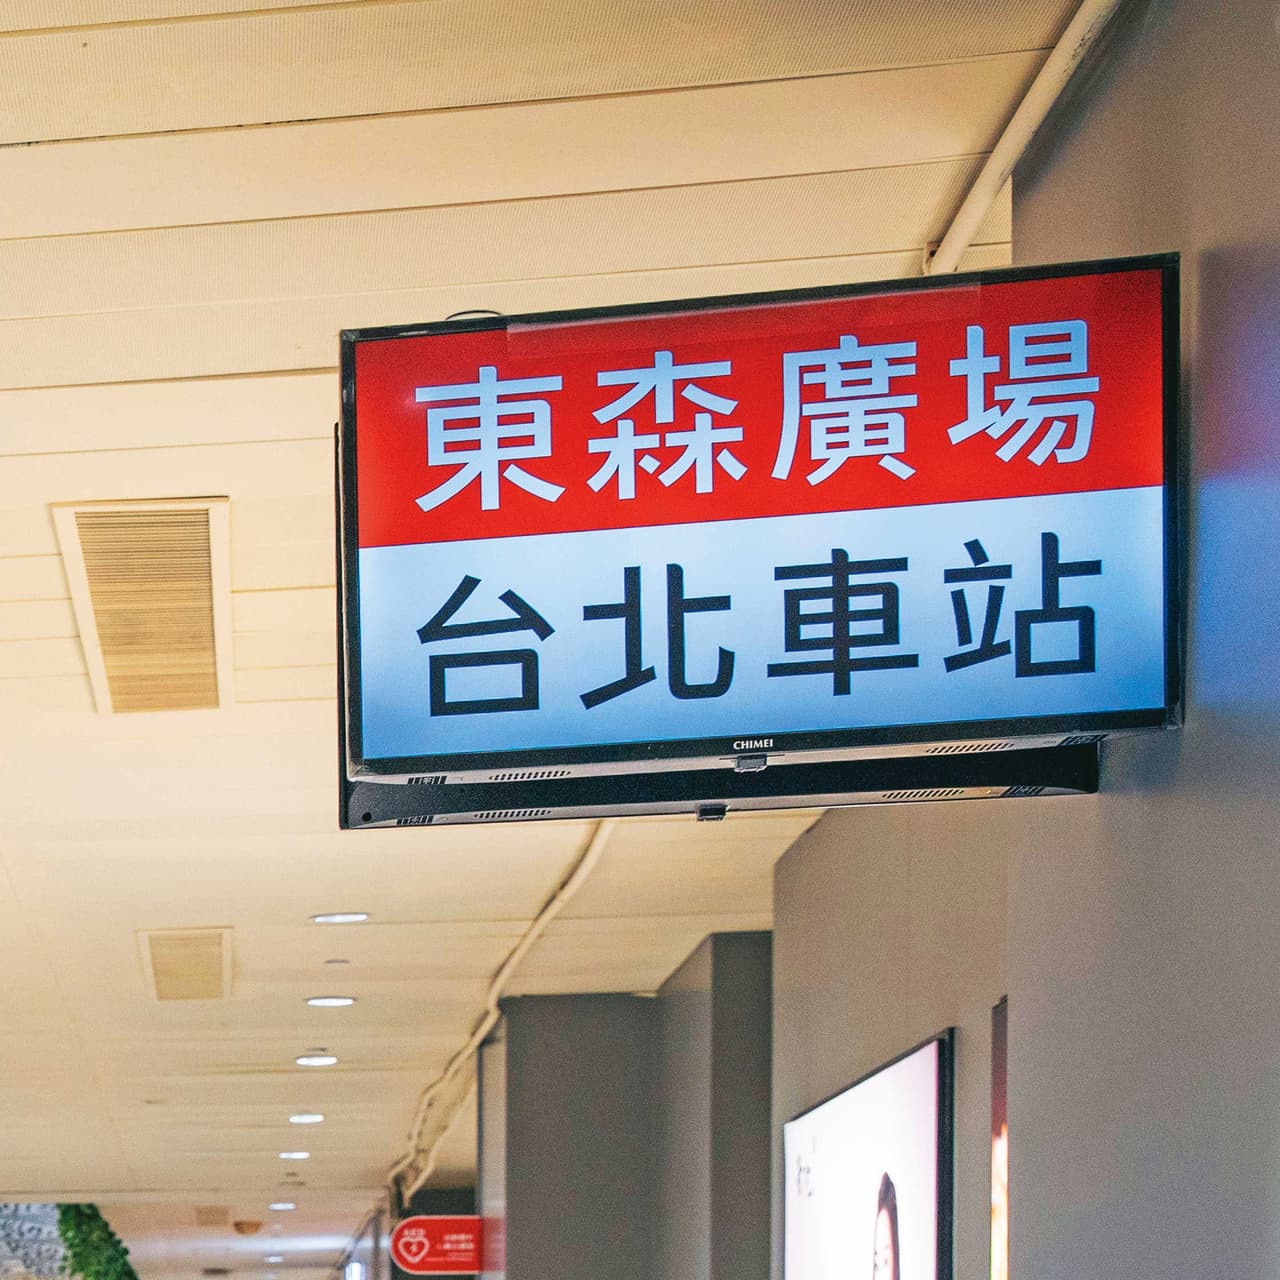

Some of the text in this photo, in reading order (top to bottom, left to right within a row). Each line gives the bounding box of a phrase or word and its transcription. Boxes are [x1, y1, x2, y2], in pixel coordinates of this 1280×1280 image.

[414, 319, 1101, 513] 東森廣場
[416, 531, 1102, 718] 台北車站
[732, 738, 774, 751] CHIMEI
